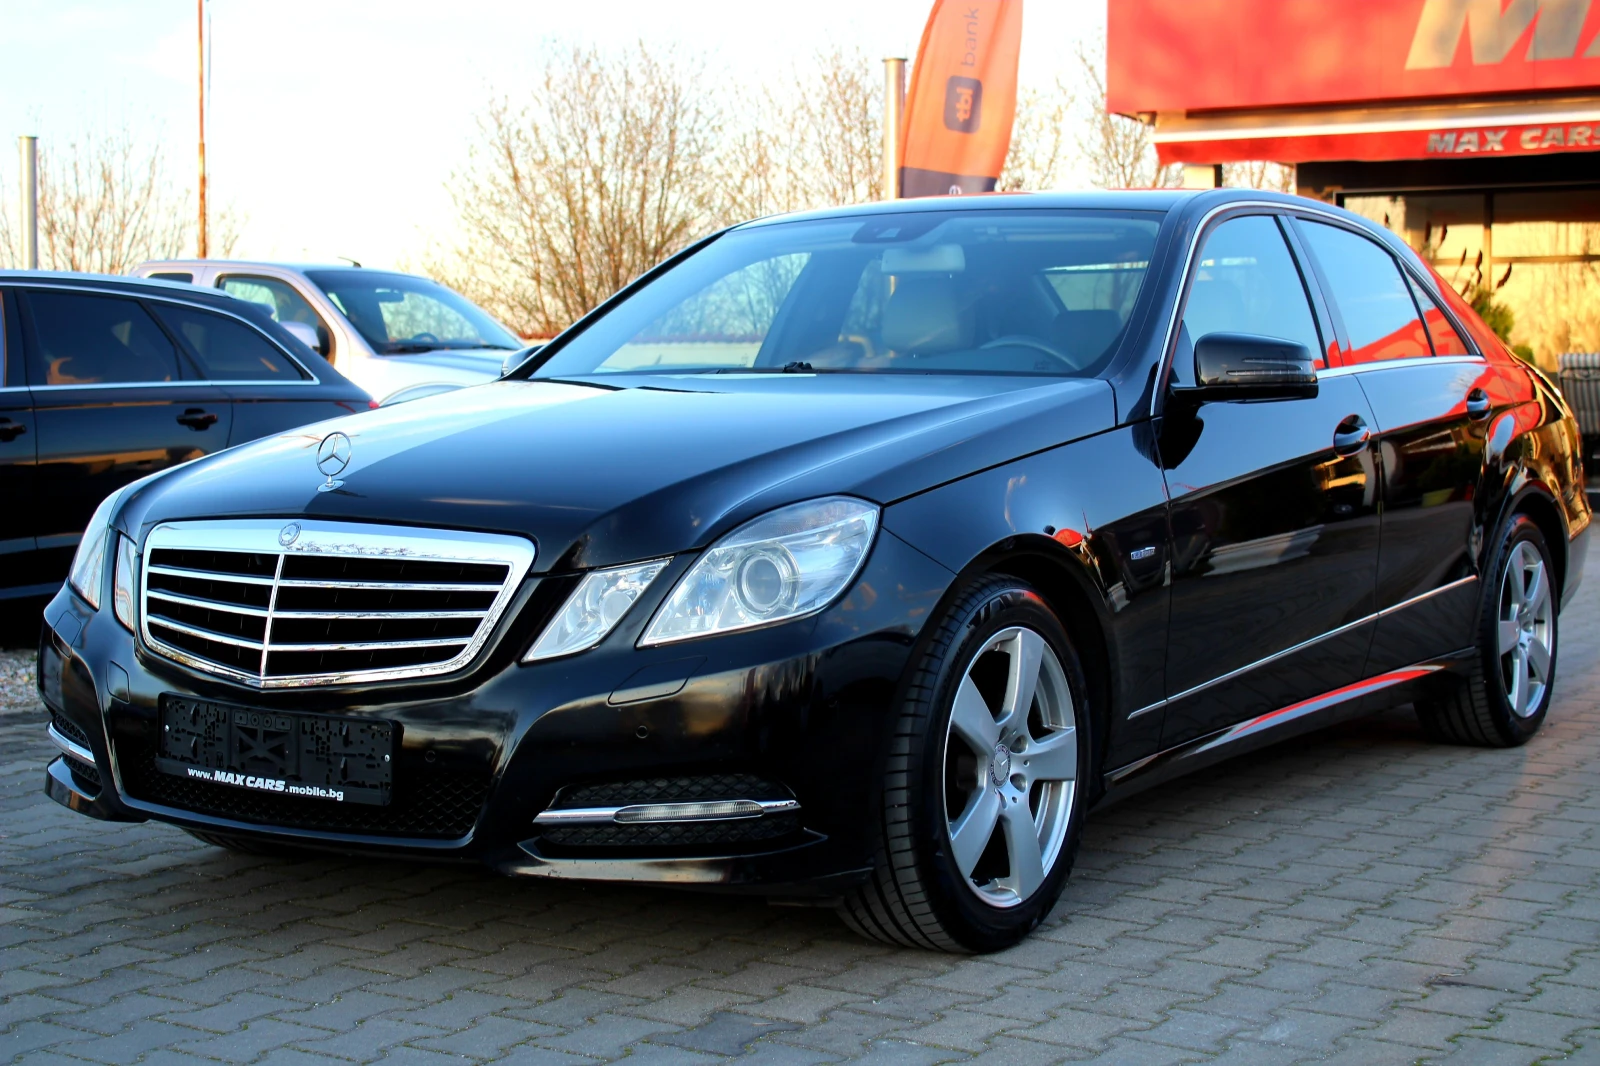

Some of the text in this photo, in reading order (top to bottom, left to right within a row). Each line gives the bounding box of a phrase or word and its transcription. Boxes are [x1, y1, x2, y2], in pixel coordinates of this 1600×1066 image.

[961, 7, 979, 67] bank
[1405, 0, 1600, 70] M
[1427, 129, 1508, 153] MAX
